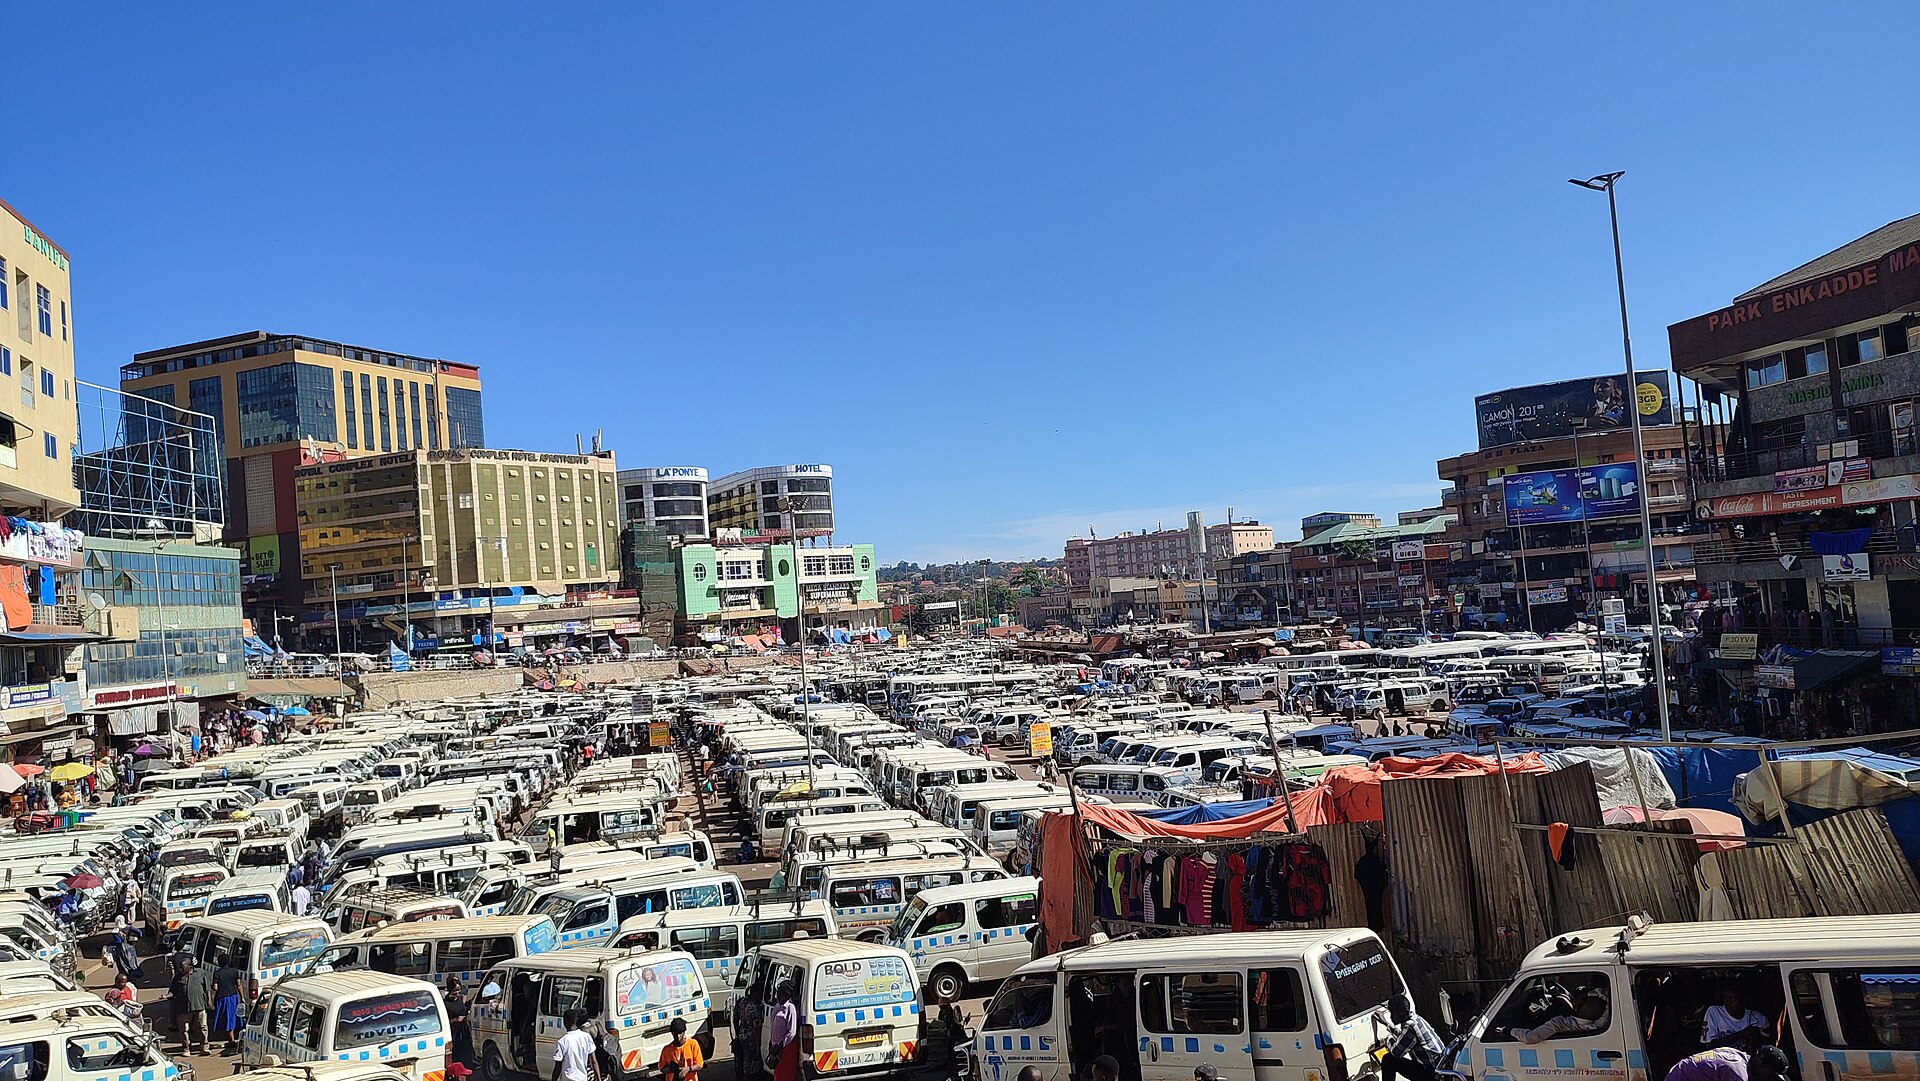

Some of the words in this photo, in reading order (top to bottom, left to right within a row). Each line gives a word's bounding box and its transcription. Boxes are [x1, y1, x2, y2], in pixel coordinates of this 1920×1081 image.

[24, 225, 65, 271] HANIFA
[1708, 300, 1762, 332] PARK
[1772, 265, 1878, 313] ENKADDE
[1786, 385, 1833, 405] MASJID
[1840, 373, 1884, 394] AMINA
[1483, 408, 1515, 423] CAMON
[470, 450, 510, 461] COMPLEX
[512, 451, 538, 462] HOTEL
[1510, 445, 1544, 455] PLAZA
[329, 460, 374, 473] COMPLEX
[795, 464, 822, 473] HOTEL
[1782, 491, 1805, 500] TASTE
[1782, 497, 1837, 509] REFRESHMENT
[255, 552, 267, 560] BET
[256, 560, 274, 568] SURE
[810, 591, 848, 599] SUPERMARKET
[825, 962, 862, 976] BOLD
[1335, 961, 1368, 980] EMERGENCY
[354, 1023, 419, 1040] TOYOTA
